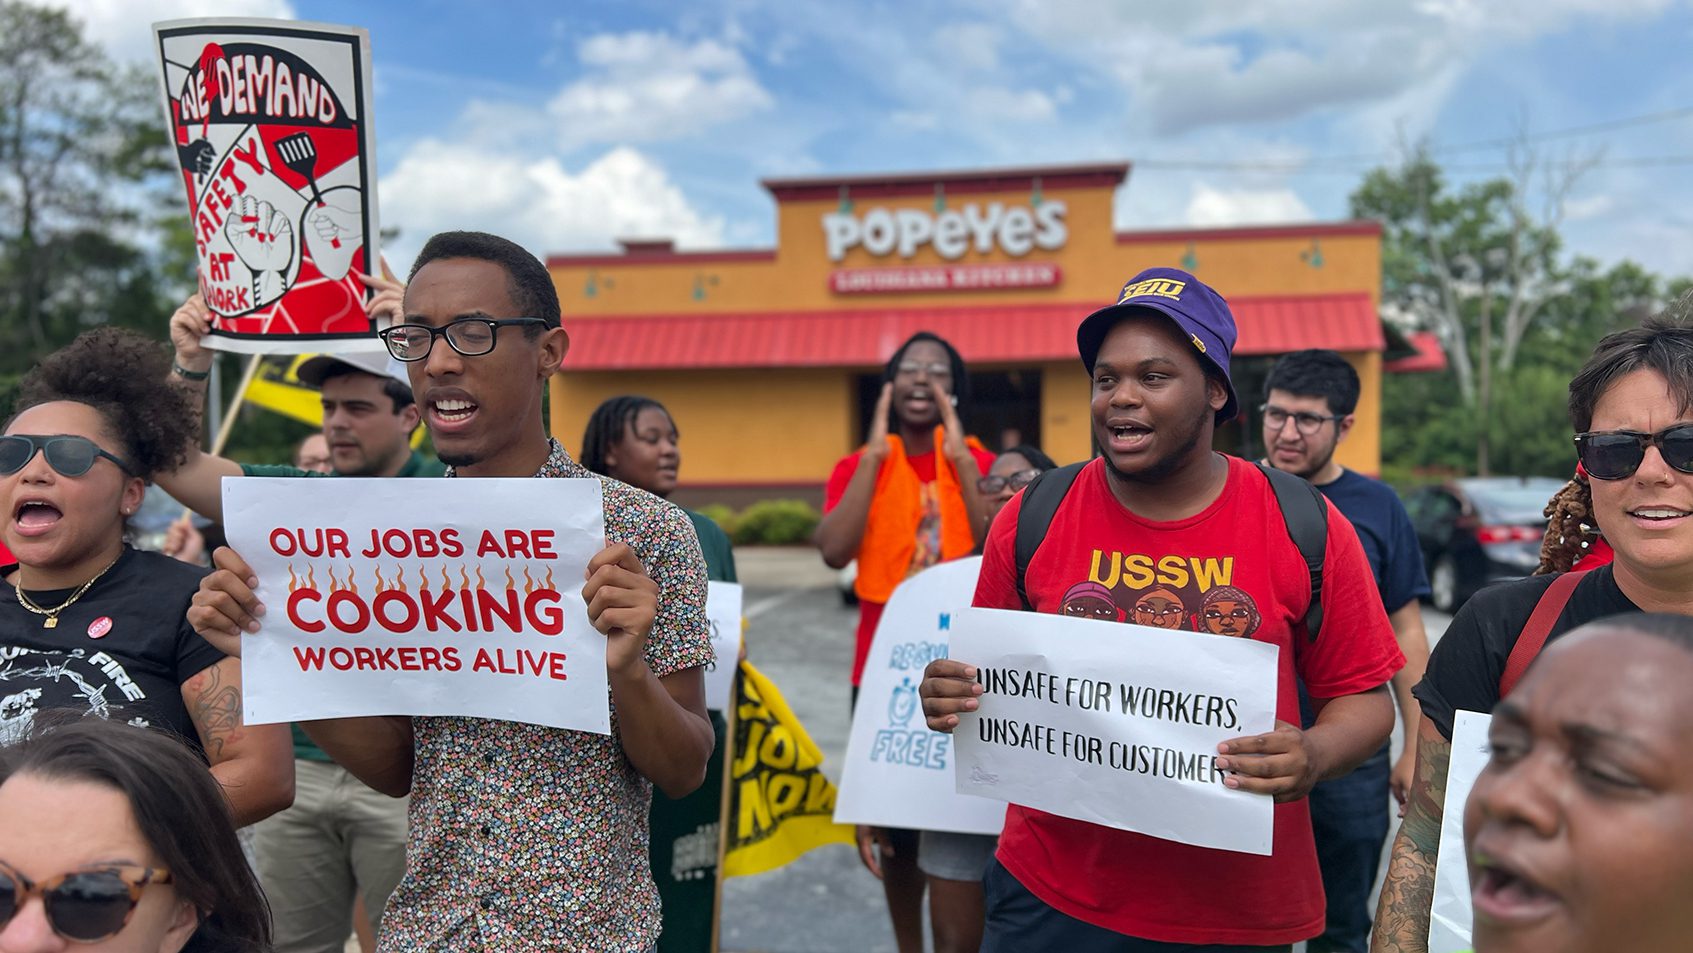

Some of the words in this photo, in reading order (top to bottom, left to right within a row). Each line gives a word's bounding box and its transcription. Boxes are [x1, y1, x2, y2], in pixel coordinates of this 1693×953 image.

[181, 69, 210, 121] WE
[216, 54, 337, 124] DEMAND
[196, 137, 264, 258] SAFETY
[210, 252, 235, 283] AT
[1123, 278, 1186, 299] SEIU
[269, 527, 350, 558] OUR
[362, 528, 465, 559] JOBS
[476, 529, 559, 560] ARE
[1088, 549, 1234, 593] USSW
[286, 587, 564, 636] COOKING
[88, 651, 146, 702] FIRE
[293, 646, 463, 672] WORKERS
[472, 648, 567, 681] ALIVE
[977, 668, 1059, 704] UNSAFE
[1065, 677, 1112, 712] FOR
[1120, 683, 1243, 732] WORKERS,
[870, 728, 949, 770] FREE
[979, 717, 1057, 755] UNSAFE
[1062, 731, 1103, 765] FOR
[1109, 741, 1233, 784] CUSTOMER
